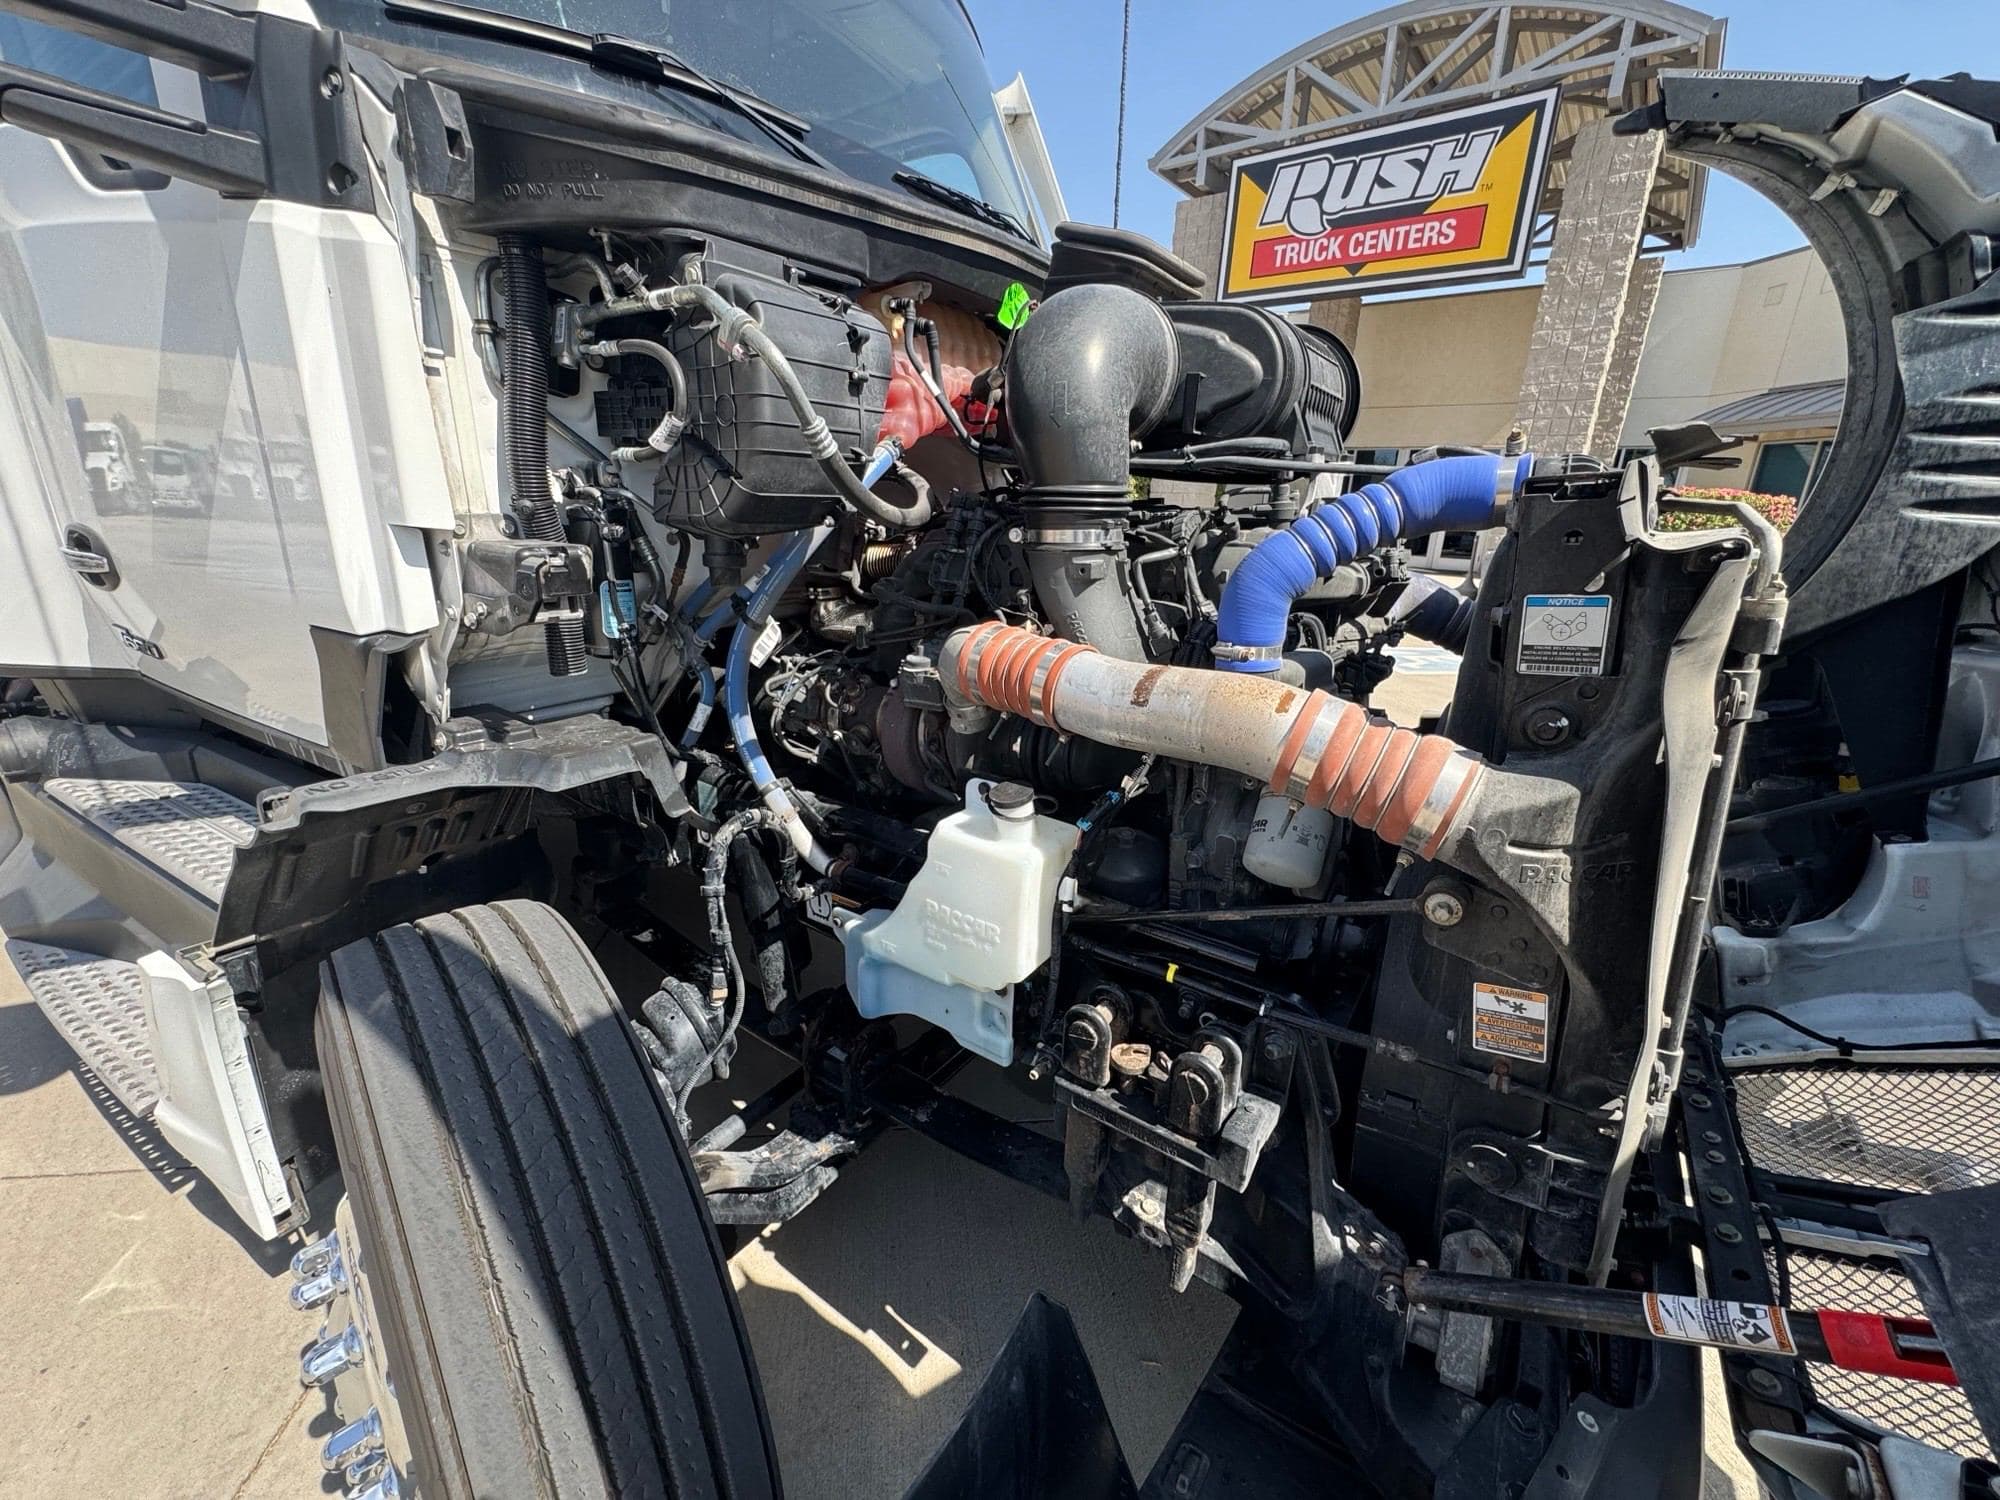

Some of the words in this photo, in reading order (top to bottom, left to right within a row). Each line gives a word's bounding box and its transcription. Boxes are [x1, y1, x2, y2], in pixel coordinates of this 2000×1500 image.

[503, 183, 521, 198] DO
[527, 182, 553, 198] NOT
[561, 183, 606, 200] PULL
[1258, 125, 1504, 239] RUSH
[1273, 233, 1346, 268] TRUCK
[1348, 217, 1457, 257] CENTERS
[1547, 598, 1585, 606] NOTICE
[1519, 861, 1638, 884] PACCAR
[925, 898, 1001, 944] PACCAR
[1498, 988, 1534, 1000] WARNING
